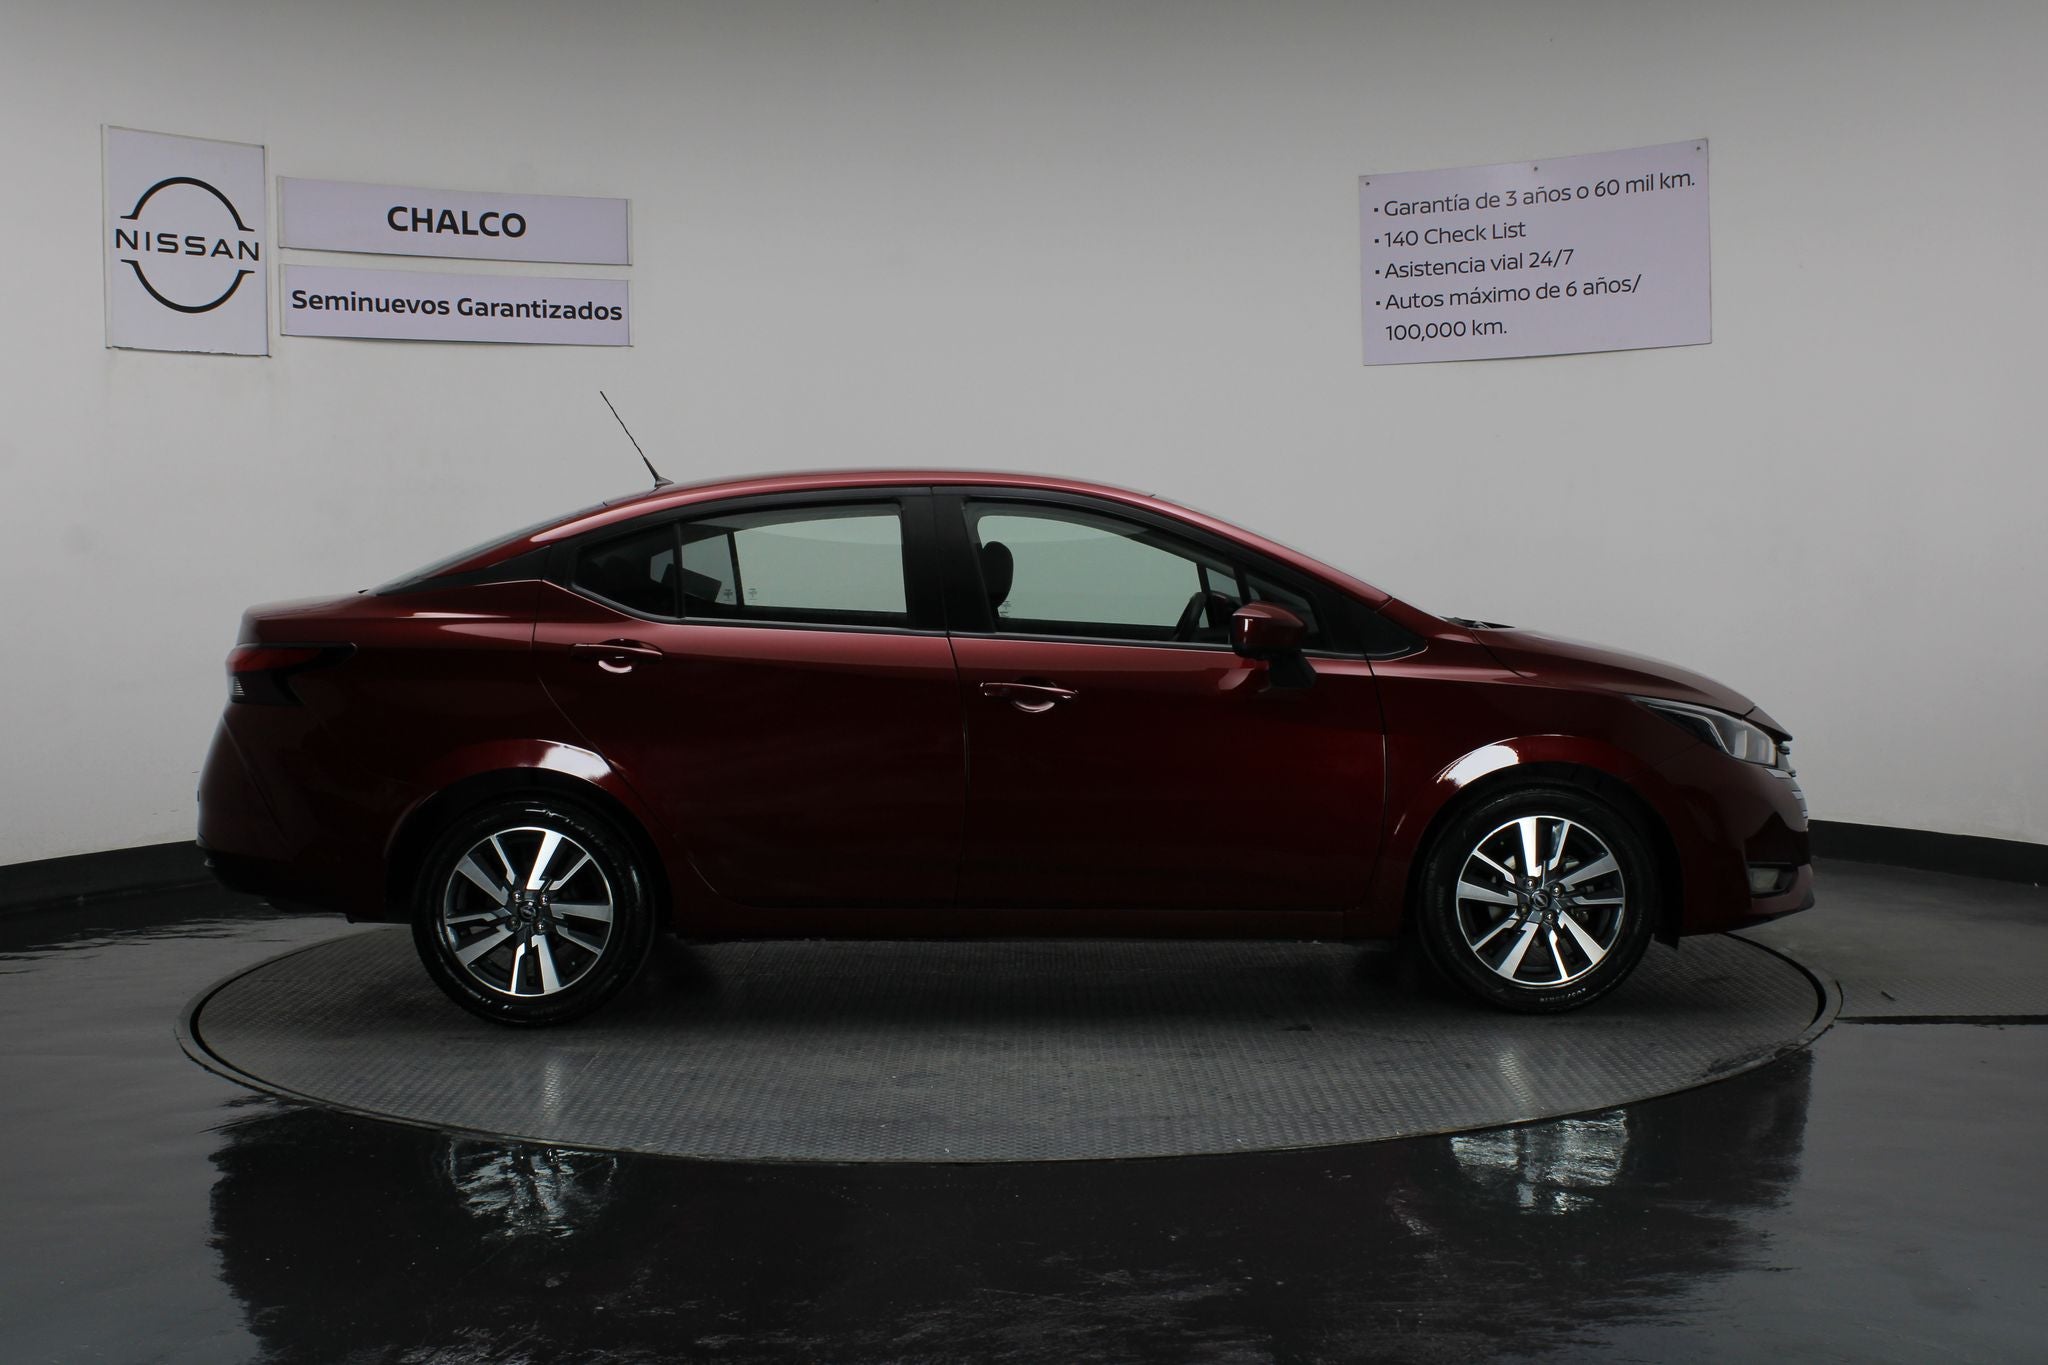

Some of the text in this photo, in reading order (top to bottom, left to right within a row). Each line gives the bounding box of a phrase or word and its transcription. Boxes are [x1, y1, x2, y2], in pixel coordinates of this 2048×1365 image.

[1383, 171, 1696, 217] Garantía de 3 años o 60 mil km.
[386, 205, 527, 239] CHALCO
[1384, 221, 1527, 248] 140 Check List
[115, 228, 260, 262] NISSAN
[1384, 248, 1575, 280] Asistencia vial 24/7
[291, 289, 623, 321] Seminuevos Garantizados
[1384, 273, 1642, 311] Autos máximo de 6 años/
[1385, 319, 1508, 342] 100,000 km.
